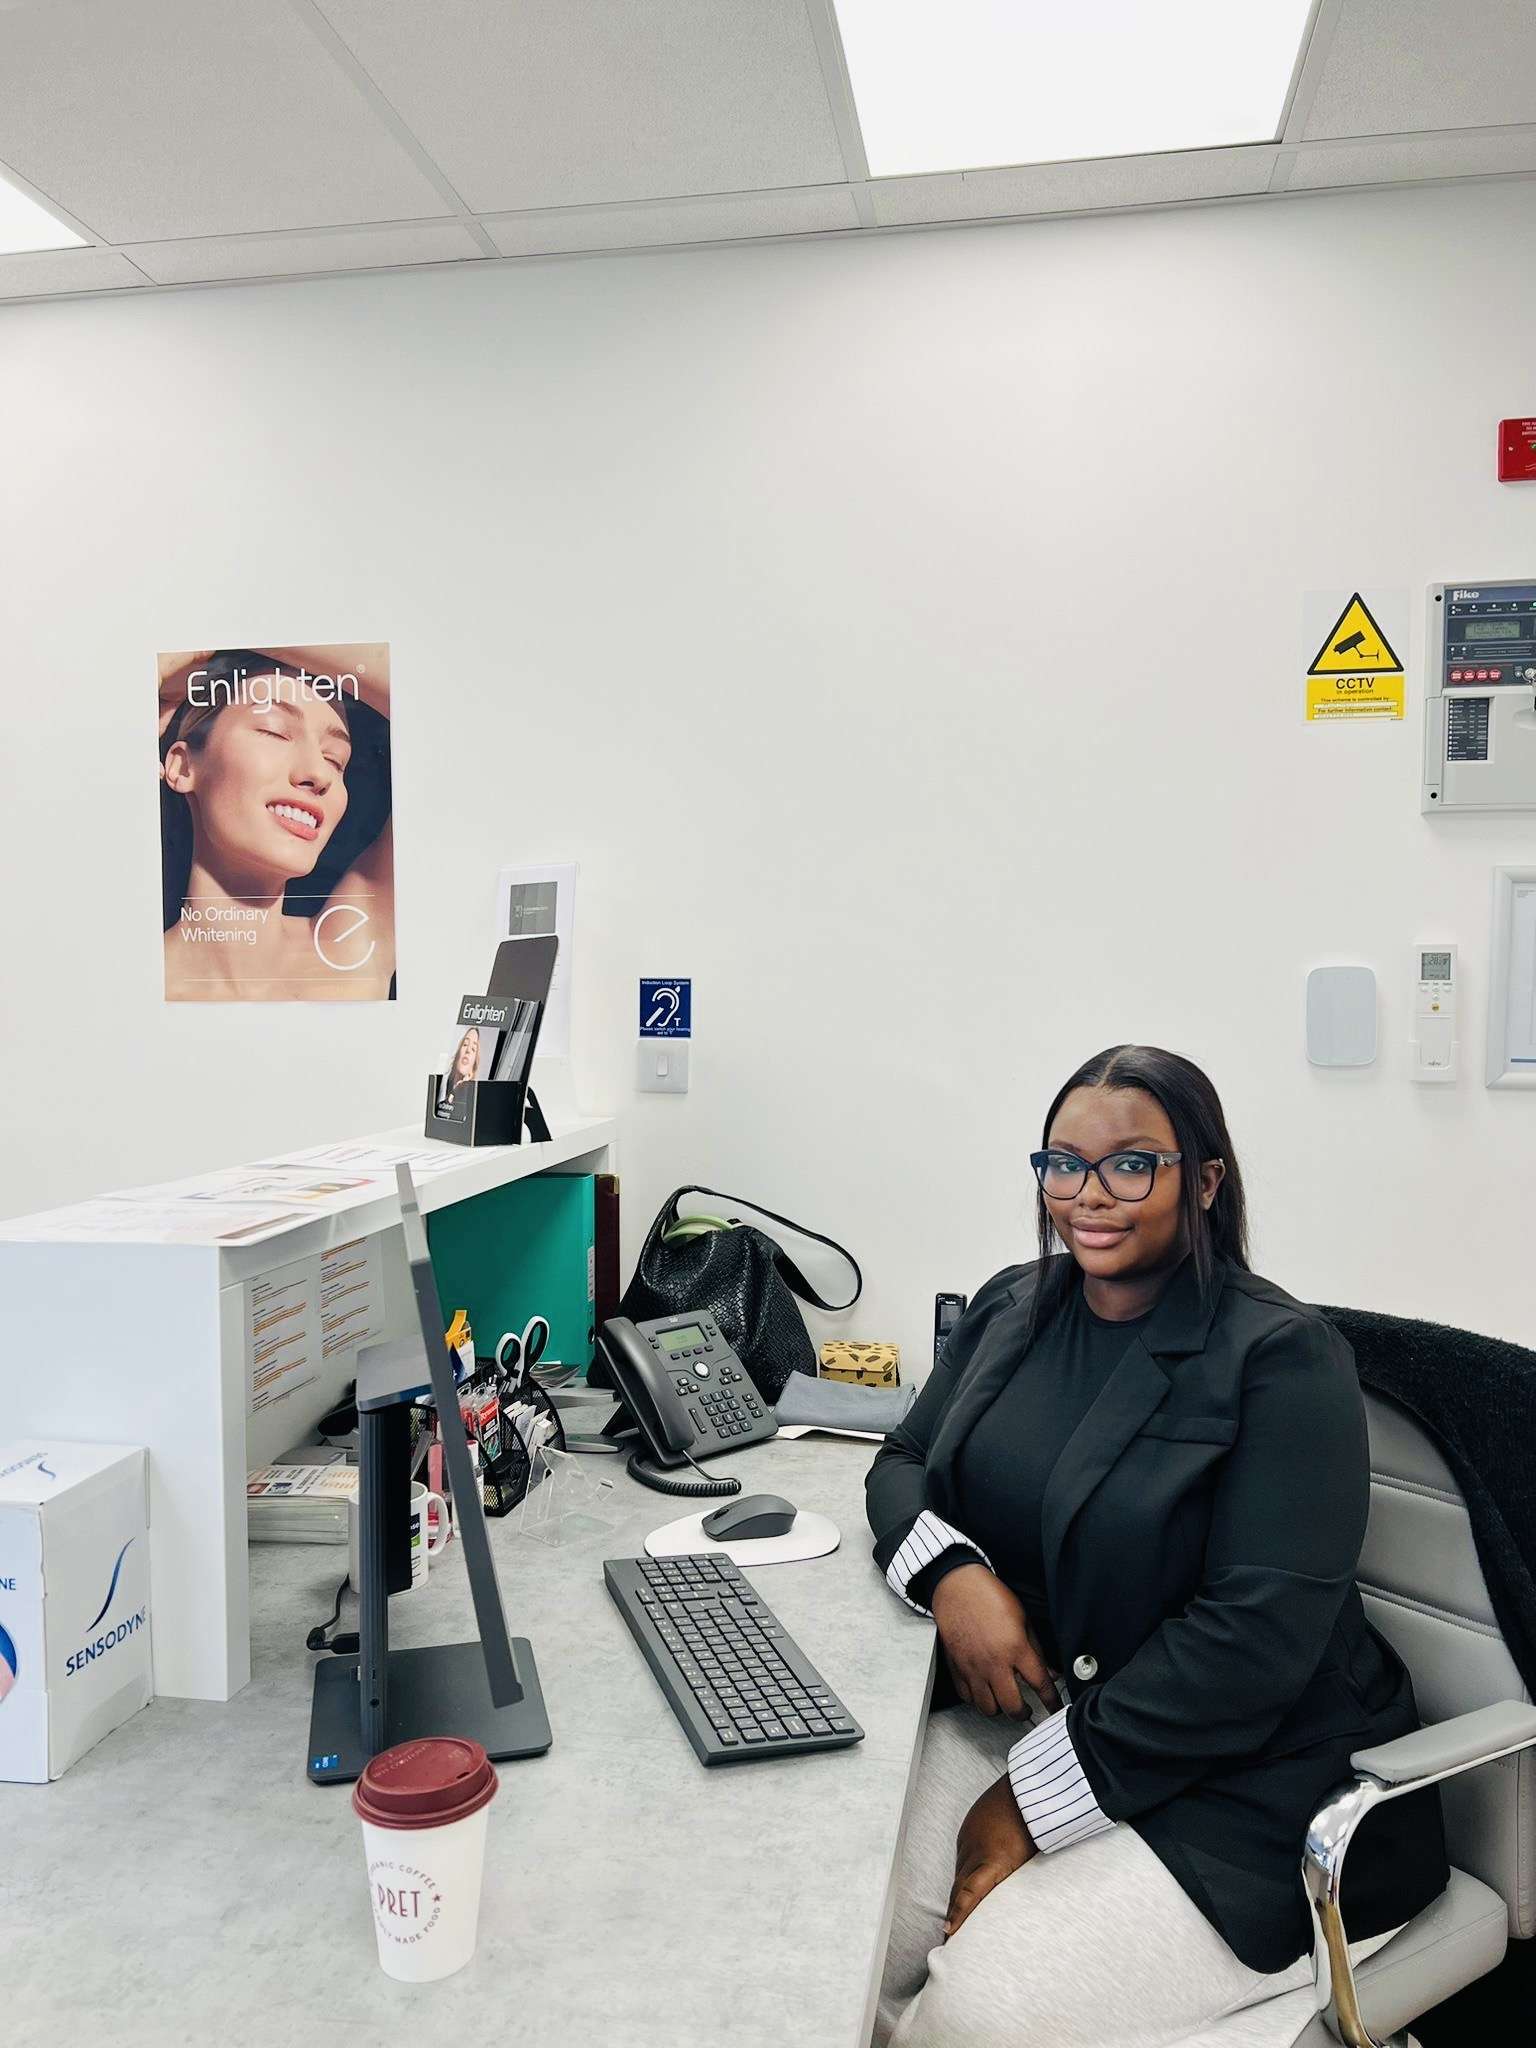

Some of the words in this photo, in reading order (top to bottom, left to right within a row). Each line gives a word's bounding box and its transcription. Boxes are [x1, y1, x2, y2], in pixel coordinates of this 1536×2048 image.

[187, 667, 359, 714] Enlighten
[1335, 677, 1375, 689] CCTV
[181, 907, 201, 922] No
[205, 906, 268, 924] Ordinary
[181, 927, 257, 945] Whitening
[463, 1003, 506, 1024] Enlighten
[673, 1017, 682, 1026] T
[399, 1864, 436, 1889] COFFEE
[377, 1883, 421, 1918] PRET
[395, 1932, 423, 1945] MADE
[423, 1906, 441, 1933] FOOD
